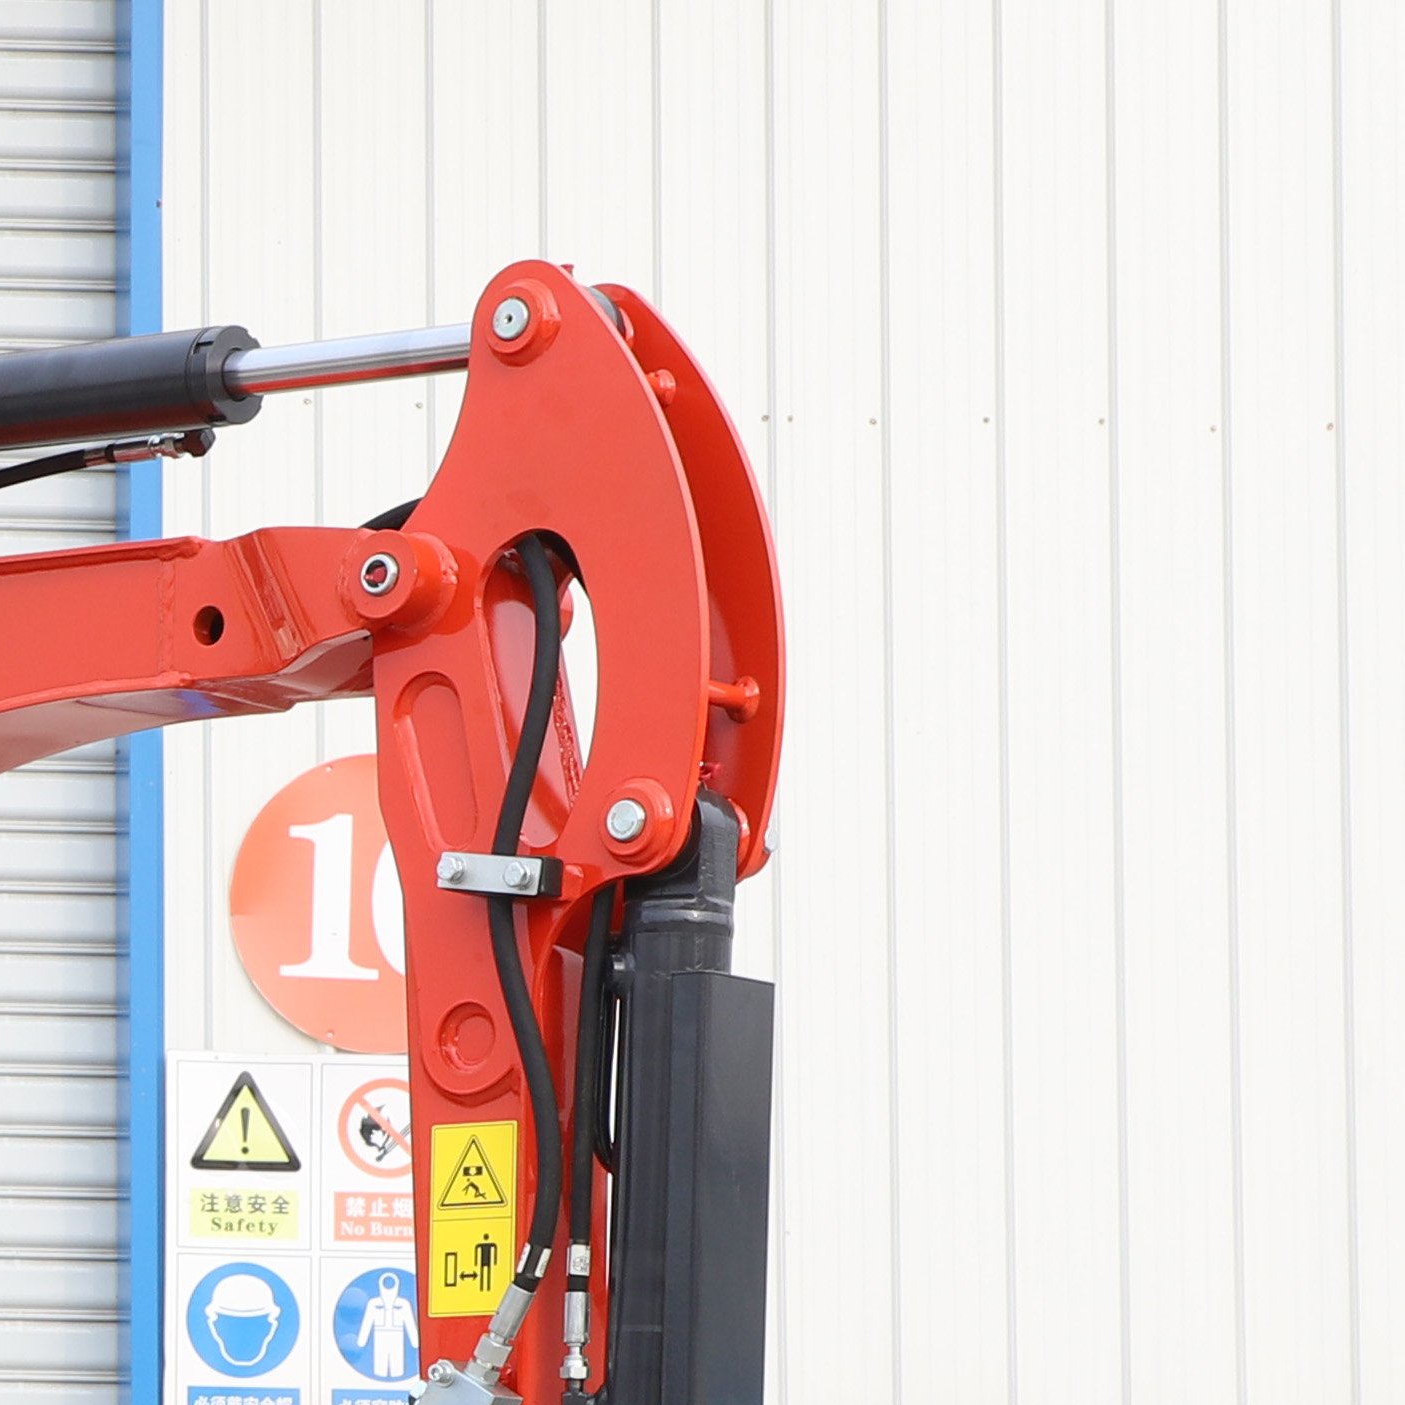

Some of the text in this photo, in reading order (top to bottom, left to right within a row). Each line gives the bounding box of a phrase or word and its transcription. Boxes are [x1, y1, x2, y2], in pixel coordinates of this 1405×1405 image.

[200, 1193, 290, 1214] 注意安全
[211, 1217, 278, 1236] Safety
[340, 1221, 365, 1235] No
